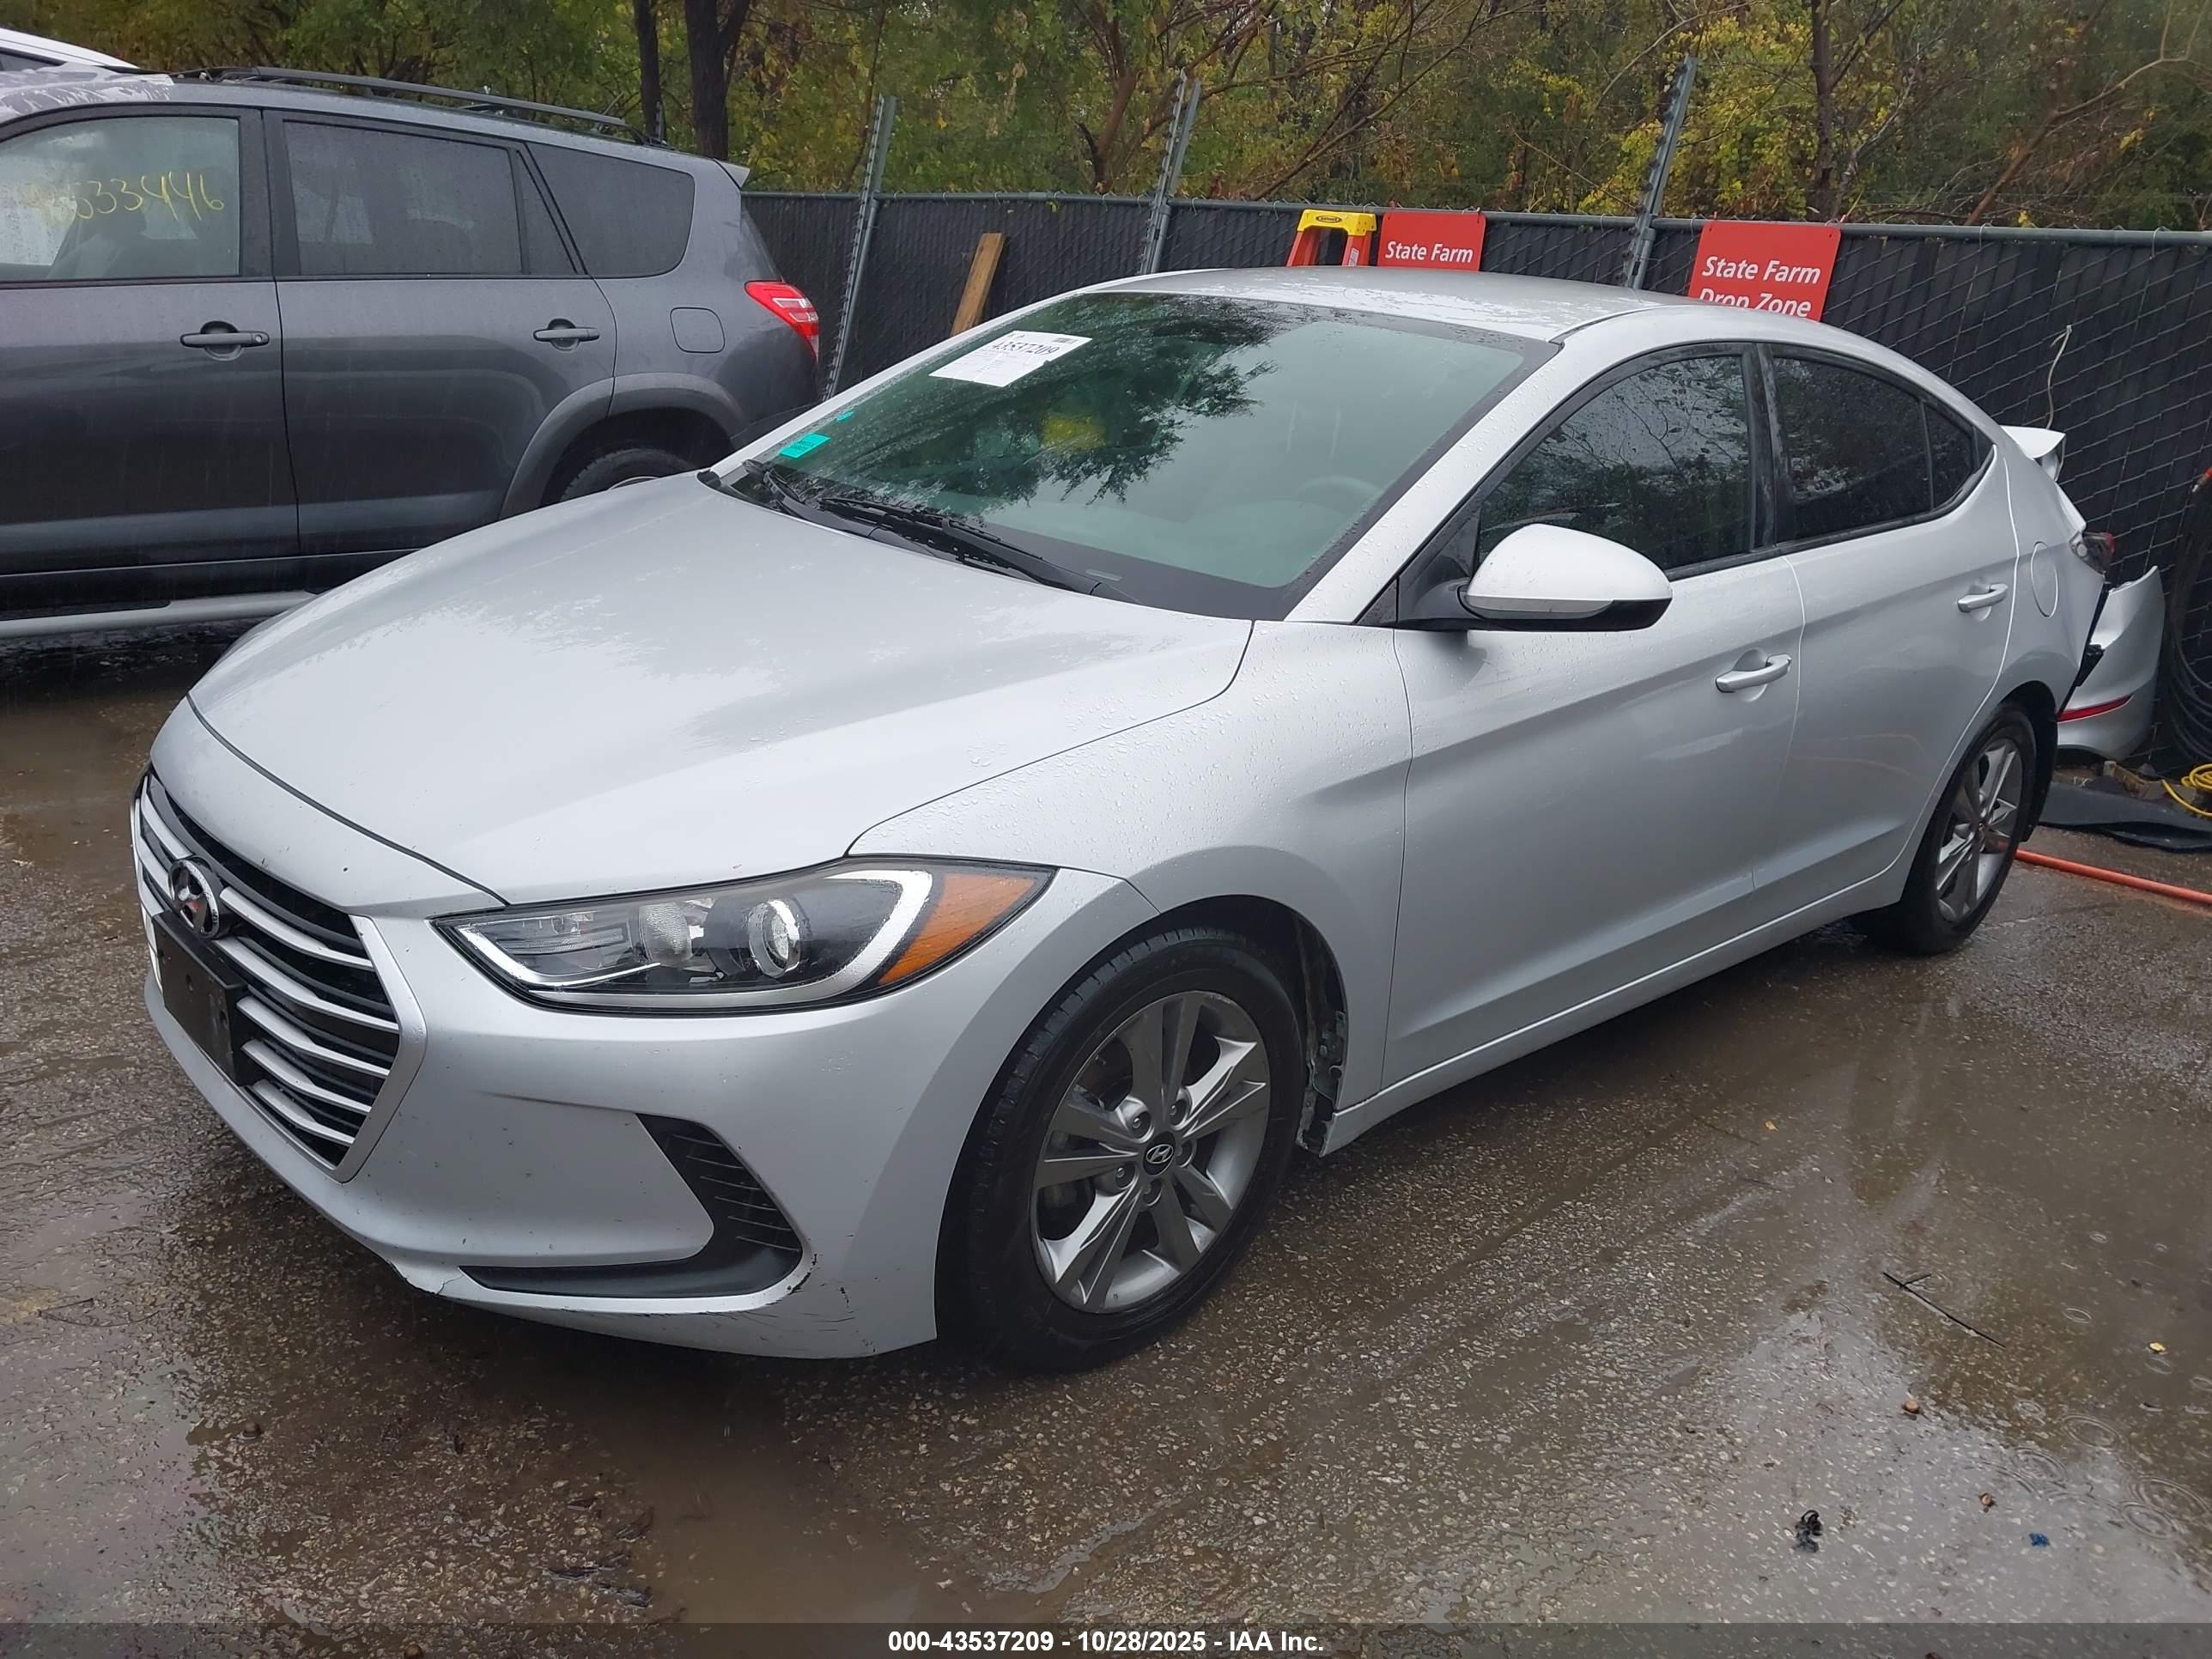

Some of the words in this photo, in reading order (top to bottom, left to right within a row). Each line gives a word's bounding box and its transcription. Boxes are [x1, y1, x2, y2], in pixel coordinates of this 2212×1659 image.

[1384, 240, 1427, 260] State
[1431, 243, 1474, 263] Farm
[1701, 255, 1759, 279] State
[1763, 259, 1821, 284] Farm
[1754, 292, 1812, 318] Zone
